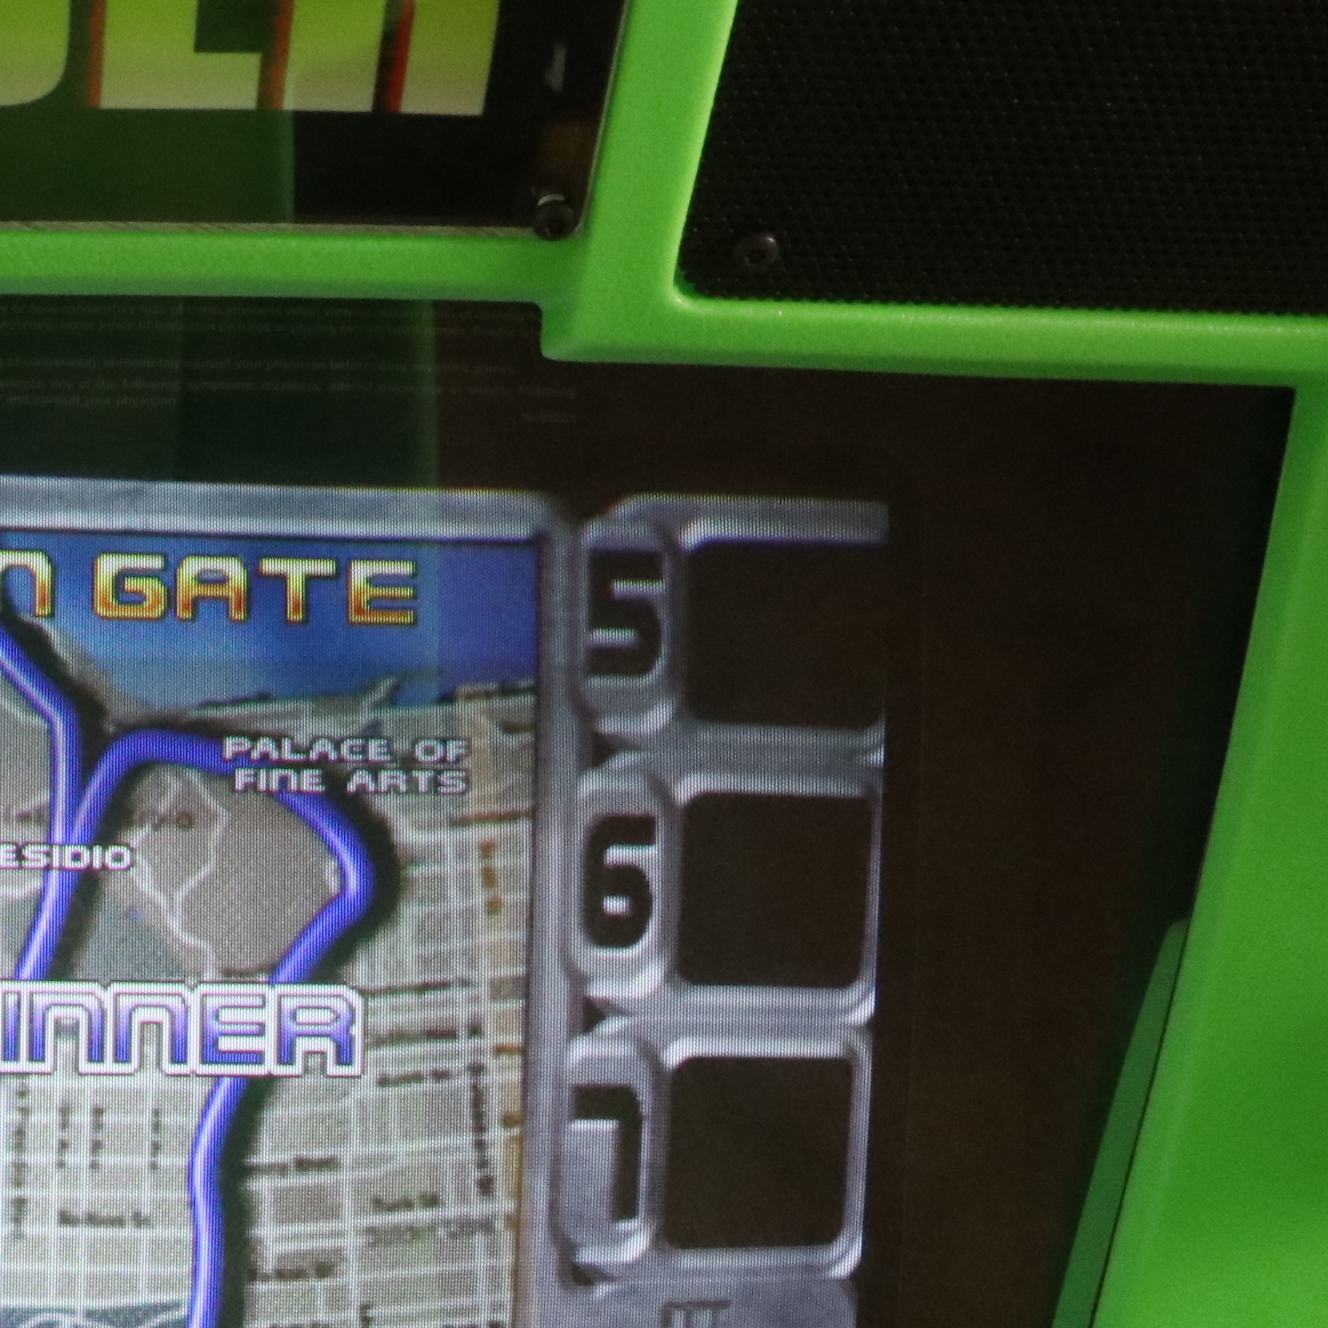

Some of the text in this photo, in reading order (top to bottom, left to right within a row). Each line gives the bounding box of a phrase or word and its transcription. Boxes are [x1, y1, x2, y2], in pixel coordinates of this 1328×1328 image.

[92, 551, 418, 625] GATE
[588, 549, 665, 678] 5
[222, 735, 471, 764] PALACE OF
[234, 767, 469, 796] FINE ARTS
[582, 813, 657, 948] 6
[572, 1083, 643, 1220] 7
